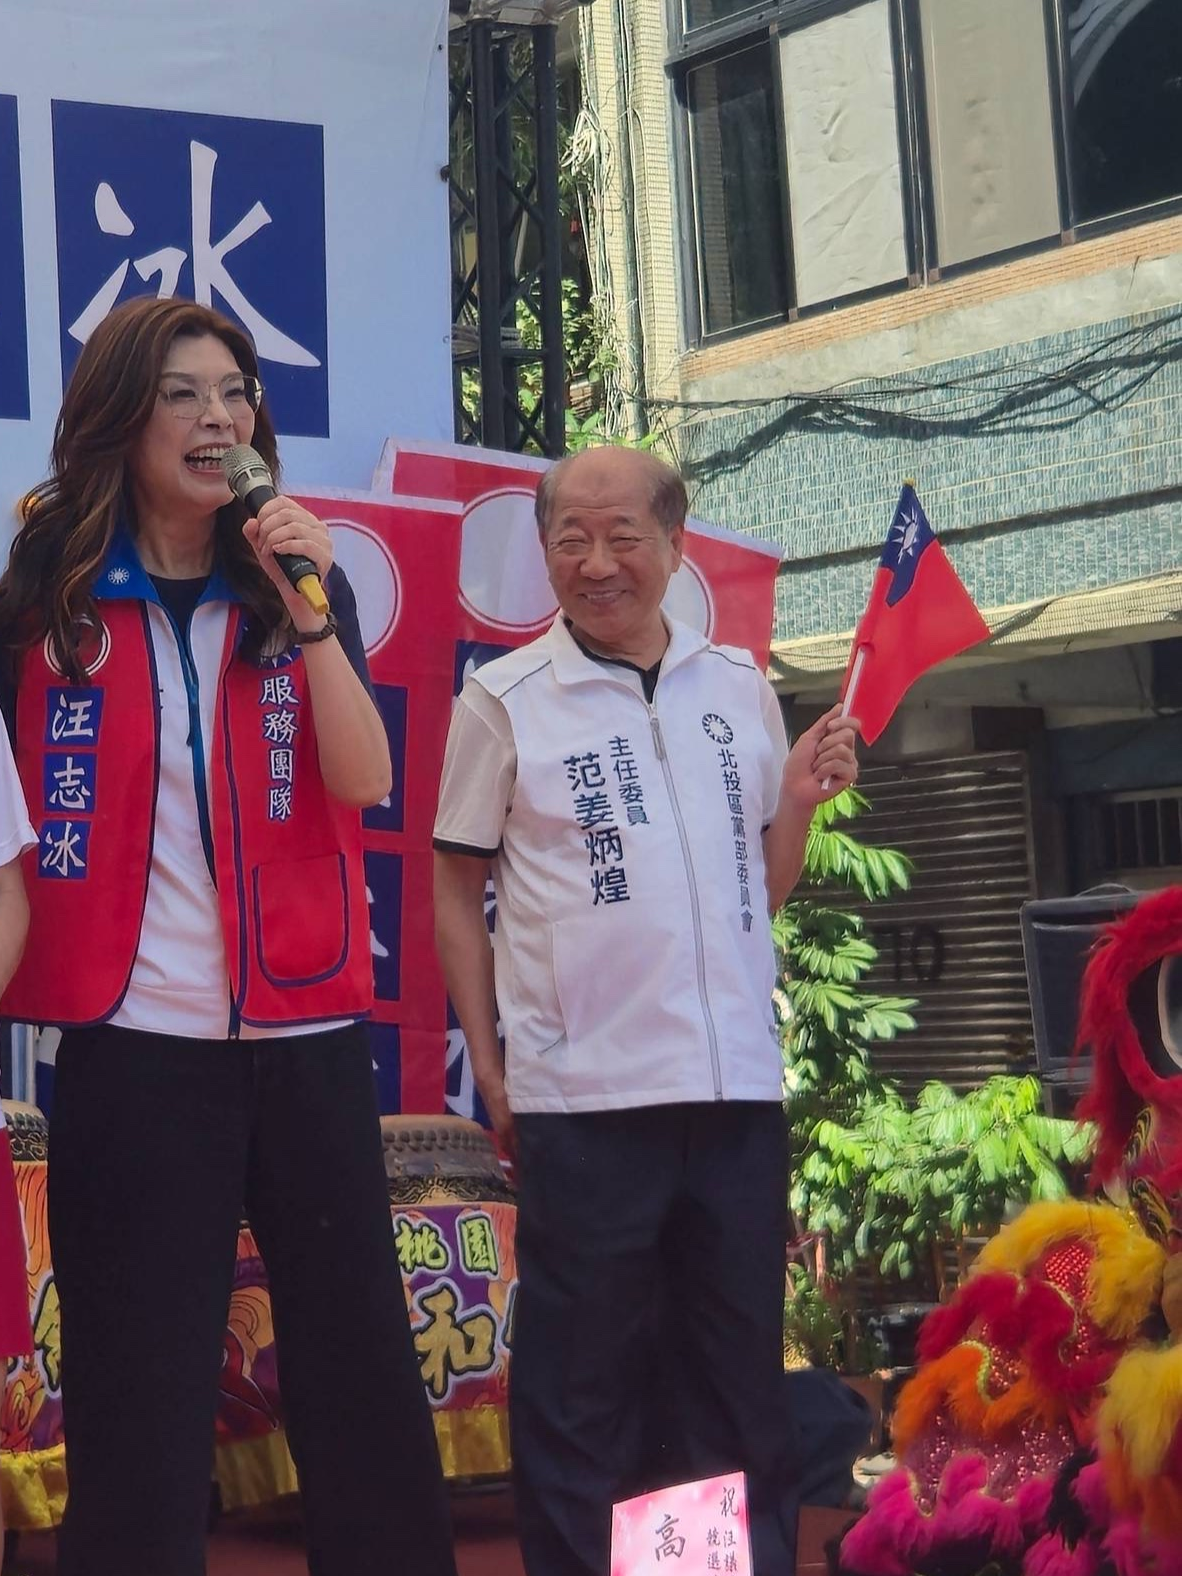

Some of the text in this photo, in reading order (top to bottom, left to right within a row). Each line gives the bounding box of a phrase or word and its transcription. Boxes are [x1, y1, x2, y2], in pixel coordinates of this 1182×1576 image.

[41, 693, 96, 878] 汪志冰
[260, 675, 300, 821] 服務團隊
[608, 735, 650, 827] 主任委員
[563, 752, 631, 906] 范姜炳煌
[718, 749, 753, 933] 北投區黨部委員會
[394, 1219, 499, 1276] 桃園
[655, 1514, 686, 1562] 高
